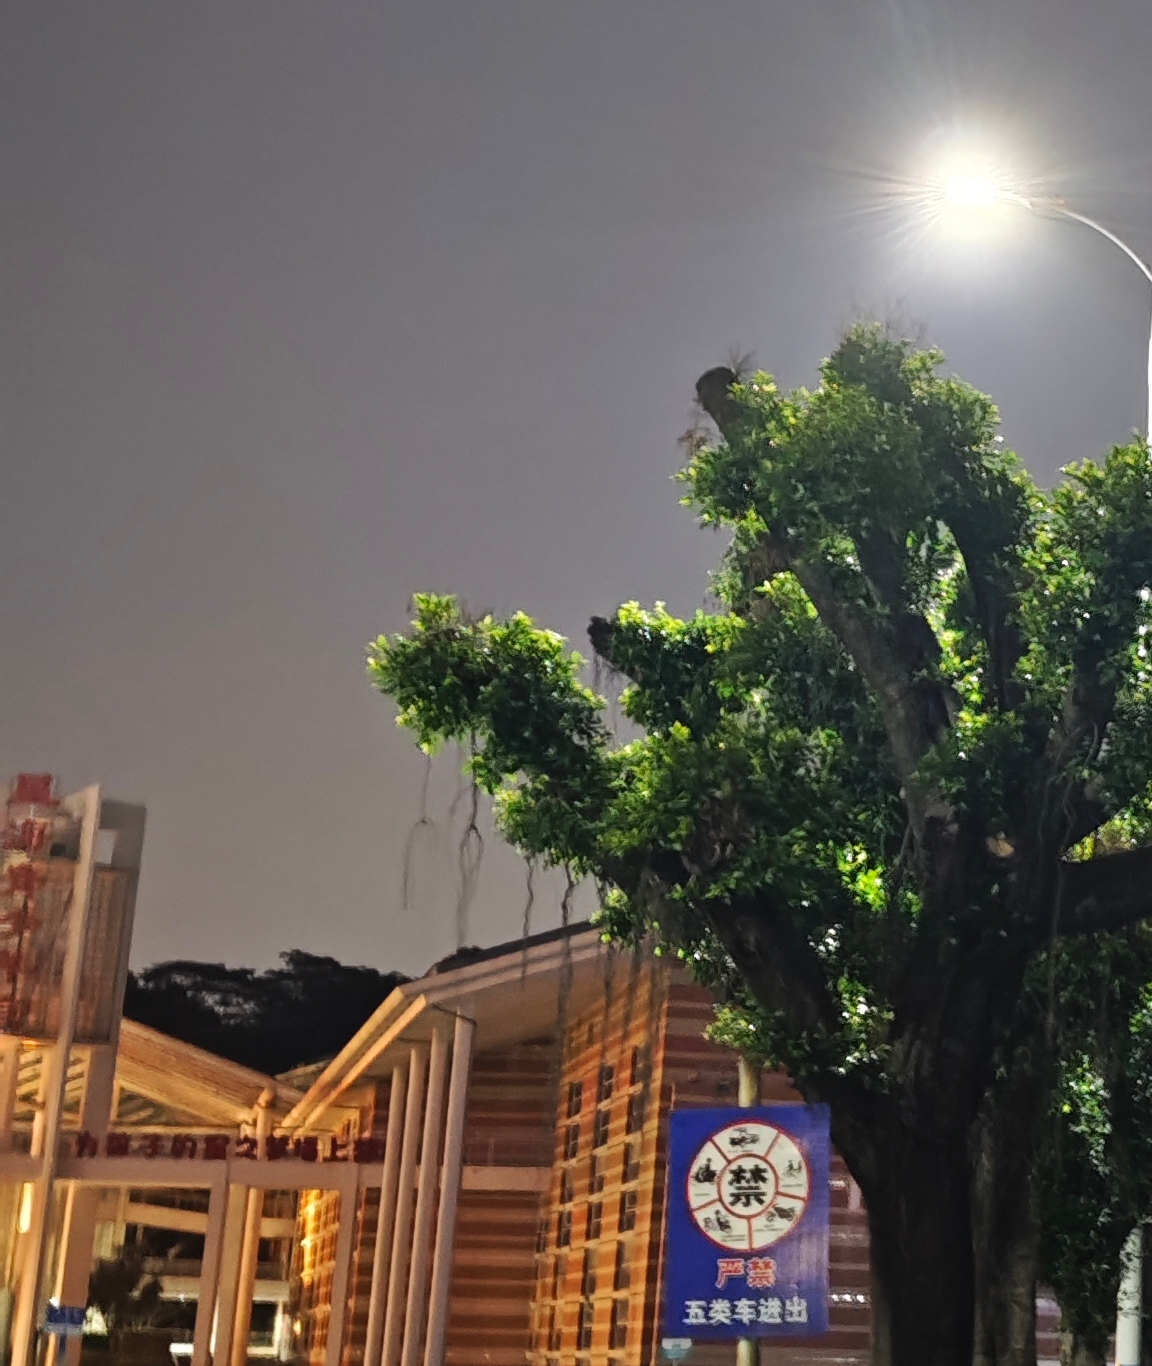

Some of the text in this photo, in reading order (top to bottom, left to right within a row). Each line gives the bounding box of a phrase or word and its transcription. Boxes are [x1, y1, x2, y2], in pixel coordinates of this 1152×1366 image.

[728, 1164, 768, 1208] 禁
[715, 1257, 777, 1290] 严禁
[682, 1296, 808, 1326] 五类车进出
